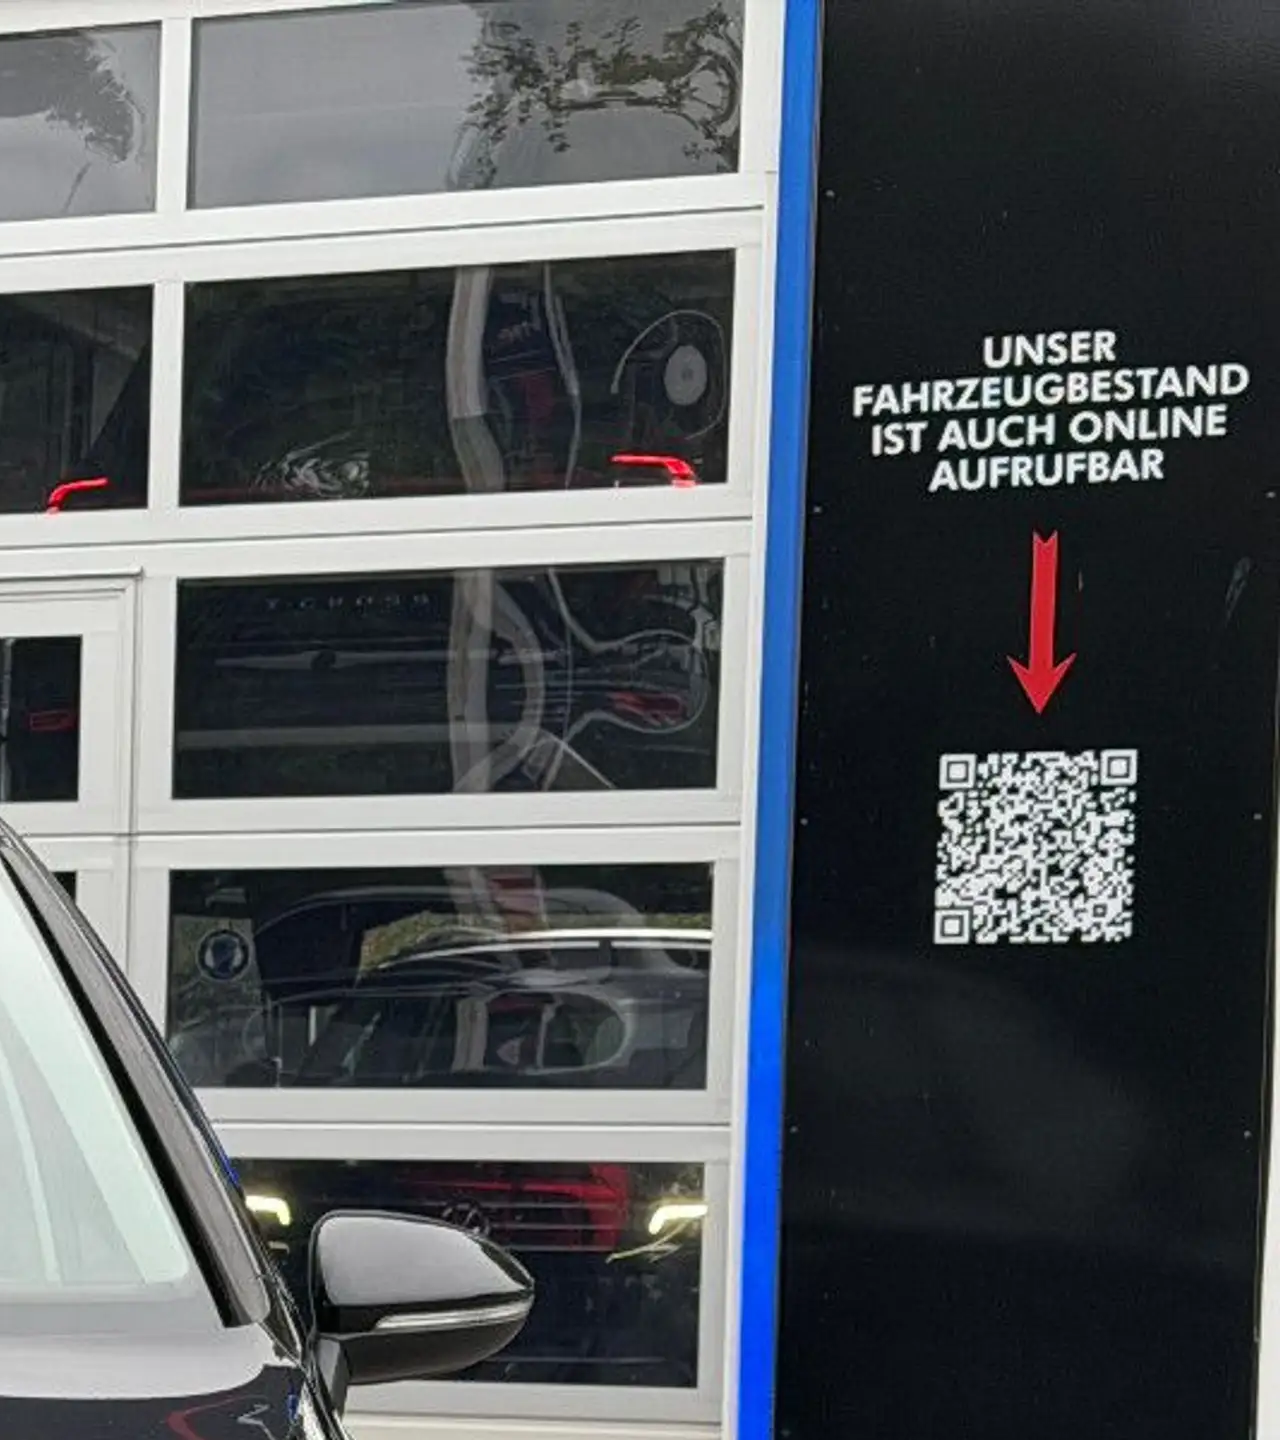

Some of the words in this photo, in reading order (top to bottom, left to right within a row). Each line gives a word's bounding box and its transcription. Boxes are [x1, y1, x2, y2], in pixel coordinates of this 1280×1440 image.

[983, 330, 1117, 369] UNSER
[852, 362, 1251, 418] FAHRZEUGBESTAND
[871, 420, 929, 457] IST
[936, 413, 1056, 453] AUCH
[1068, 402, 1228, 445] ONLINE
[927, 447, 1165, 493] AUFRUFBAR
